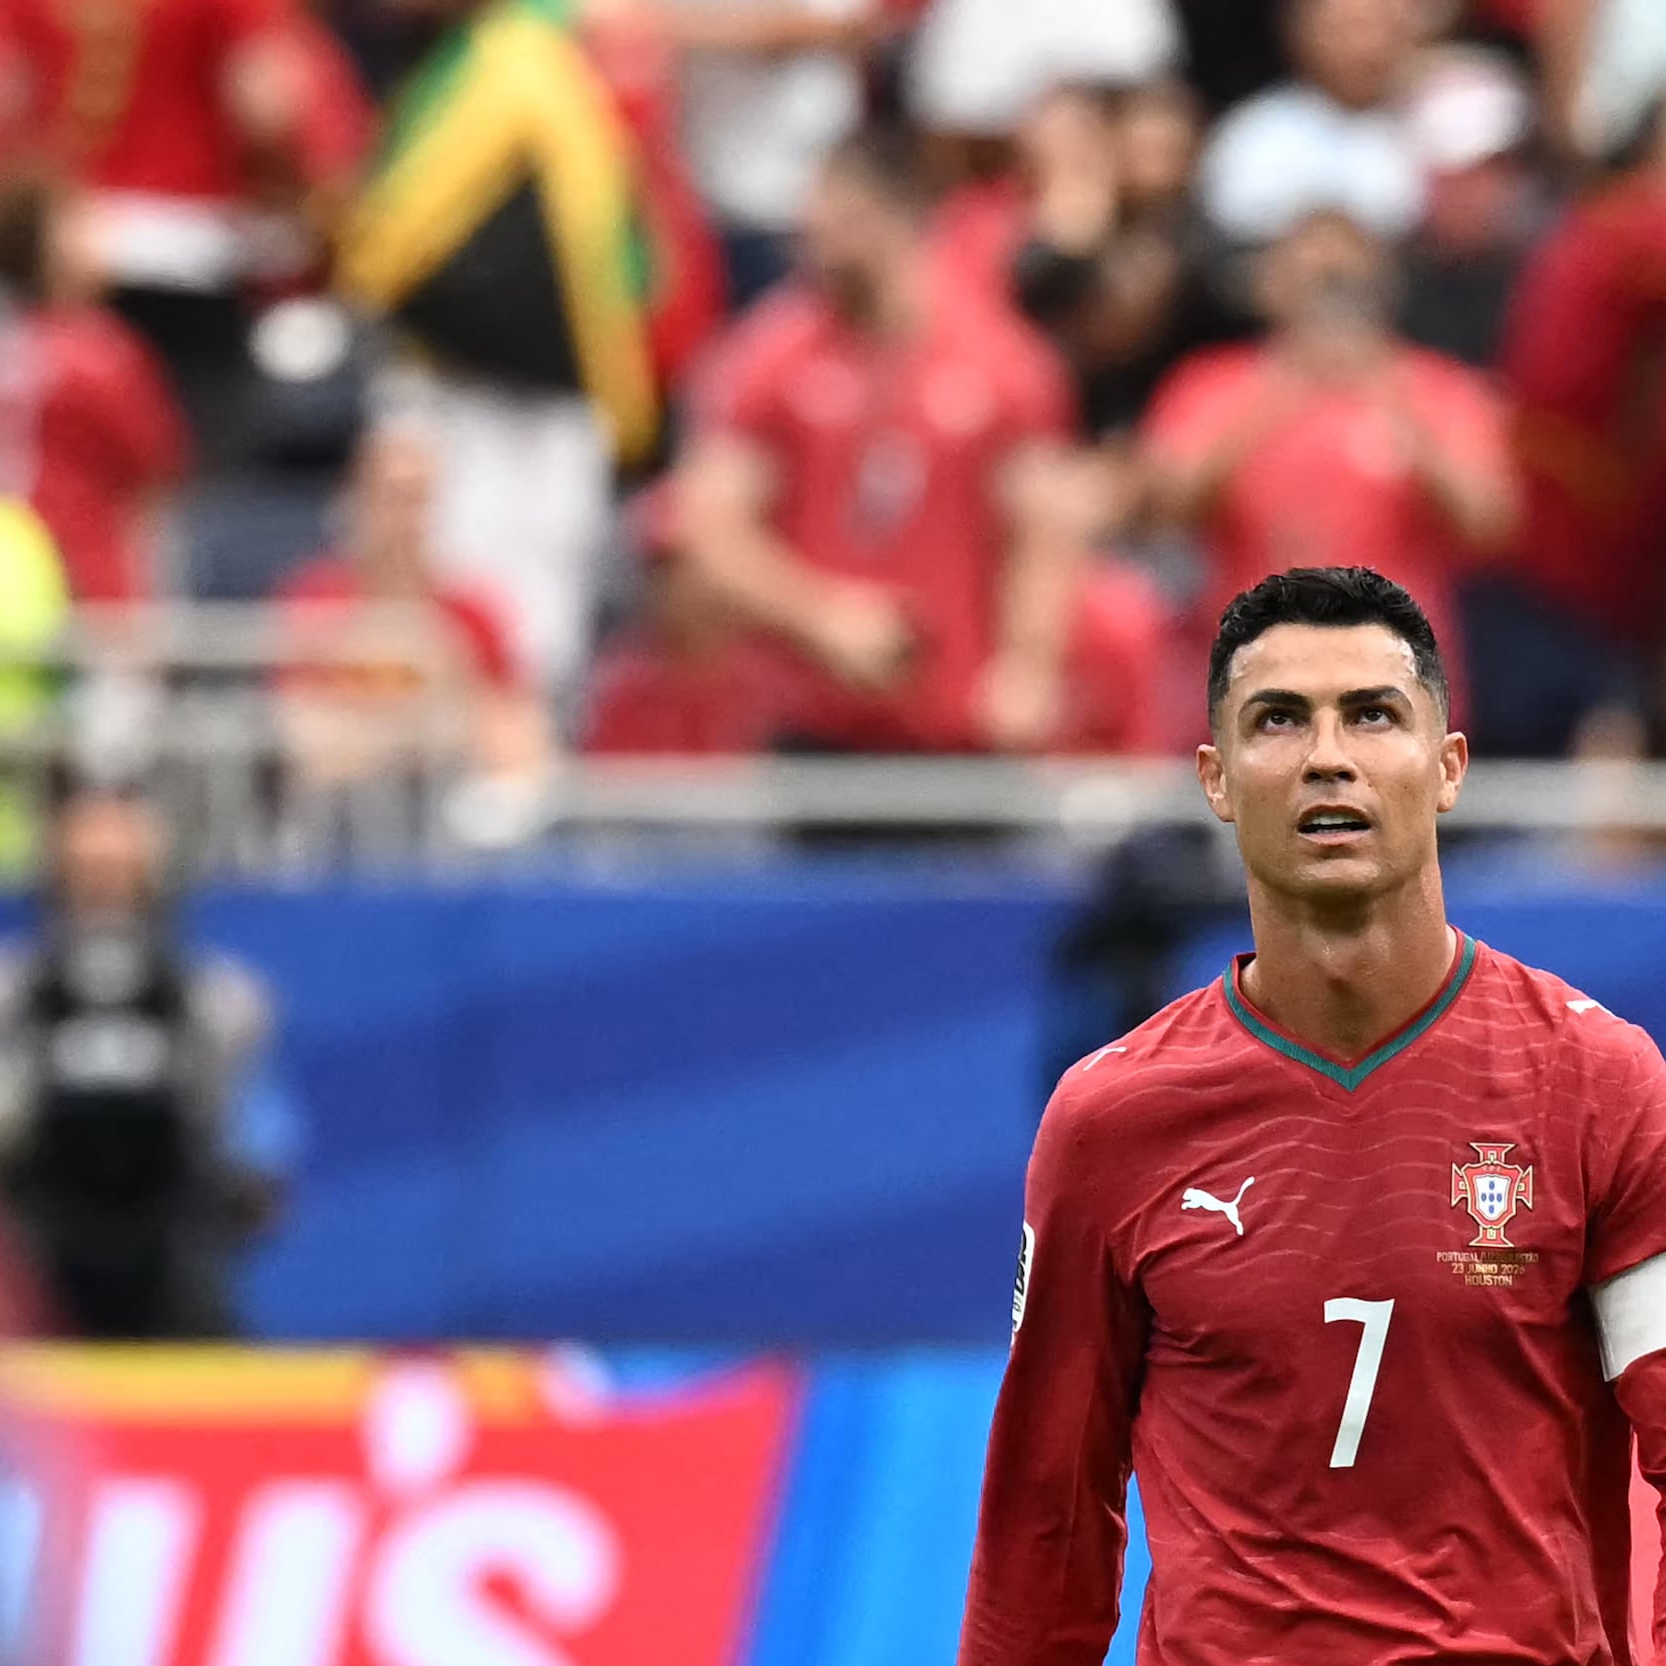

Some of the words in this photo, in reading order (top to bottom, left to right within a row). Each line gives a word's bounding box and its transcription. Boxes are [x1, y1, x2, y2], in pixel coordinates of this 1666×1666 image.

[1451, 1262, 1464, 1274] 23
[1466, 1263, 1498, 1274] JUNHO
[1464, 1274, 1513, 1286] HOUSTON
[1323, 1296, 1396, 1468] 7
